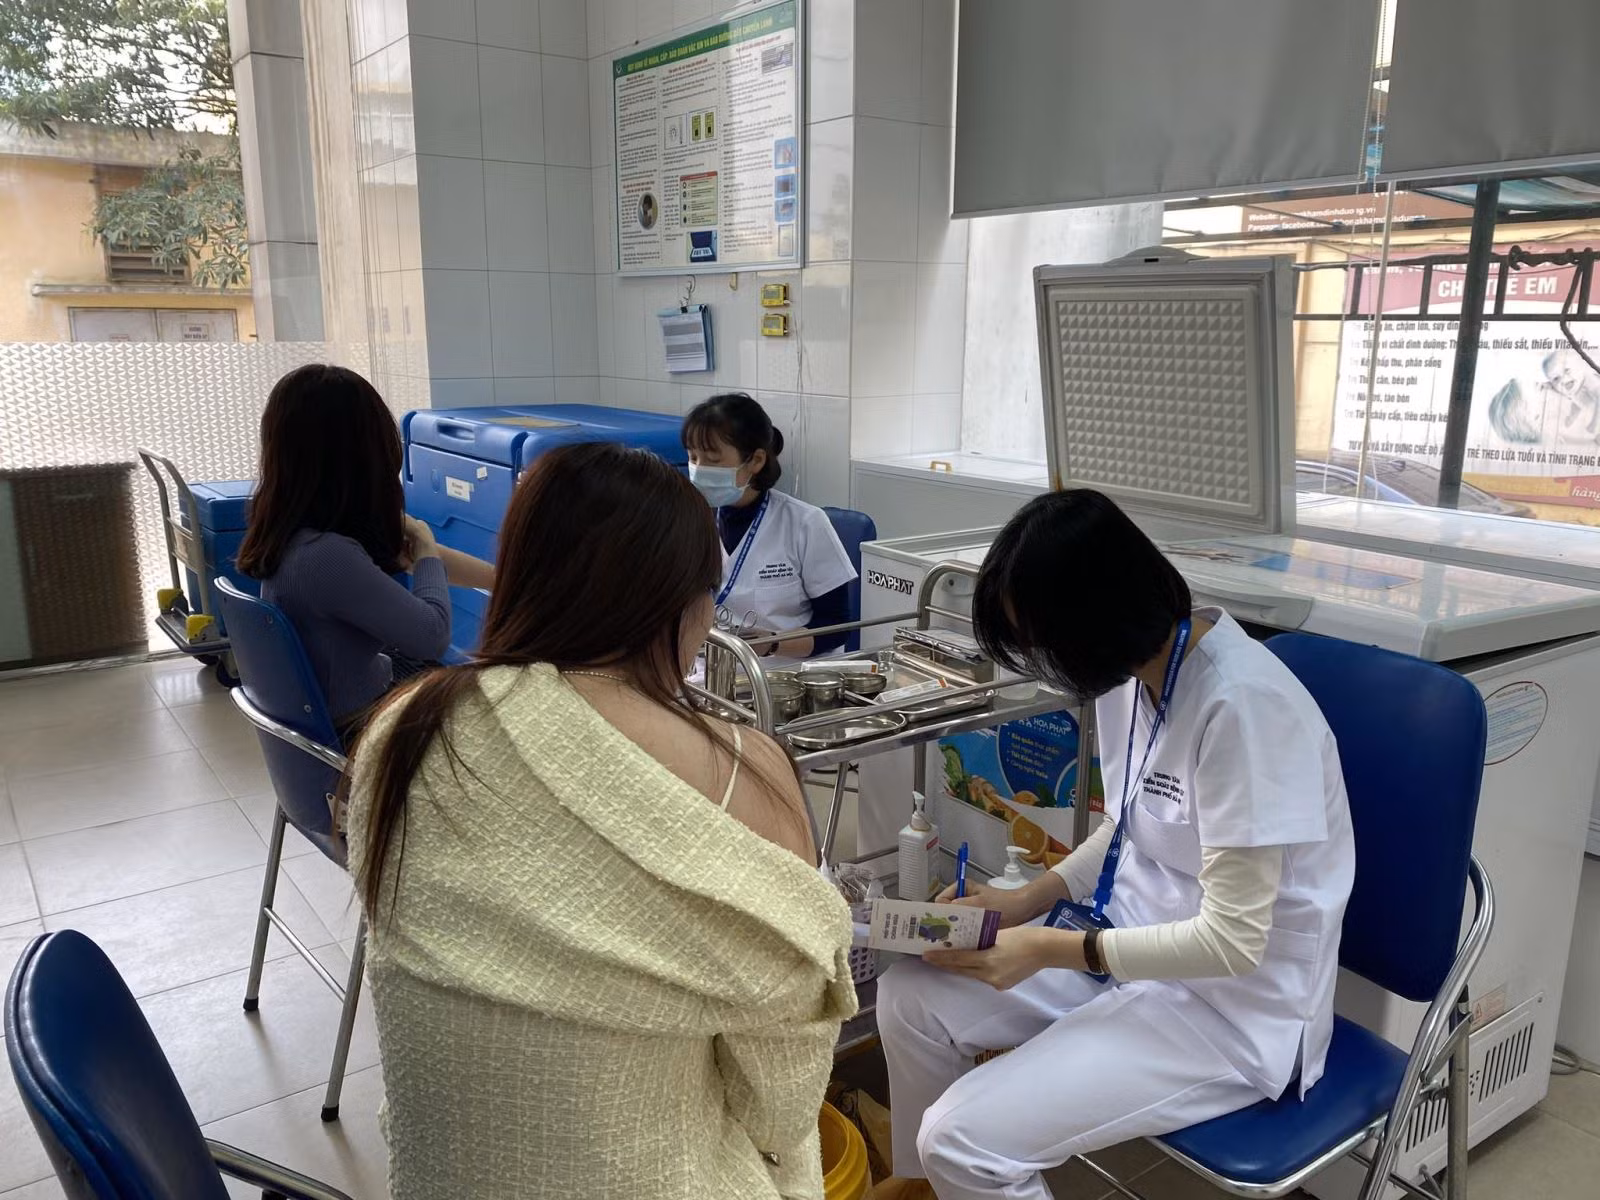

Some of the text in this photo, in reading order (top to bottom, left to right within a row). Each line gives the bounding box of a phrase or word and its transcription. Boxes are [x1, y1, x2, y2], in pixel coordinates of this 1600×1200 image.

[1438, 280, 1465, 297] CH
[1525, 276, 1558, 295] EM
[1432, 321, 1445, 331] suy
[1493, 336, 1513, 349] thiếu
[1514, 336, 1529, 350] sắt,
[1531, 337, 1553, 349] thiếu
[1467, 444, 1480, 459] TRẺ
[1482, 448, 1500, 460] THEO
[1501, 447, 1516, 461] LỨA
[1518, 447, 1536, 463] TUỔI
[1536, 450, 1547, 464] VÀ
[1549, 450, 1568, 465] TÌNH
[1569, 453, 1596, 468] TRẠNG
[1154, 772, 1171, 781] TRUNG
[1143, 786, 1161, 796] THÀNH
[1162, 791, 1172, 800] PHỐ
